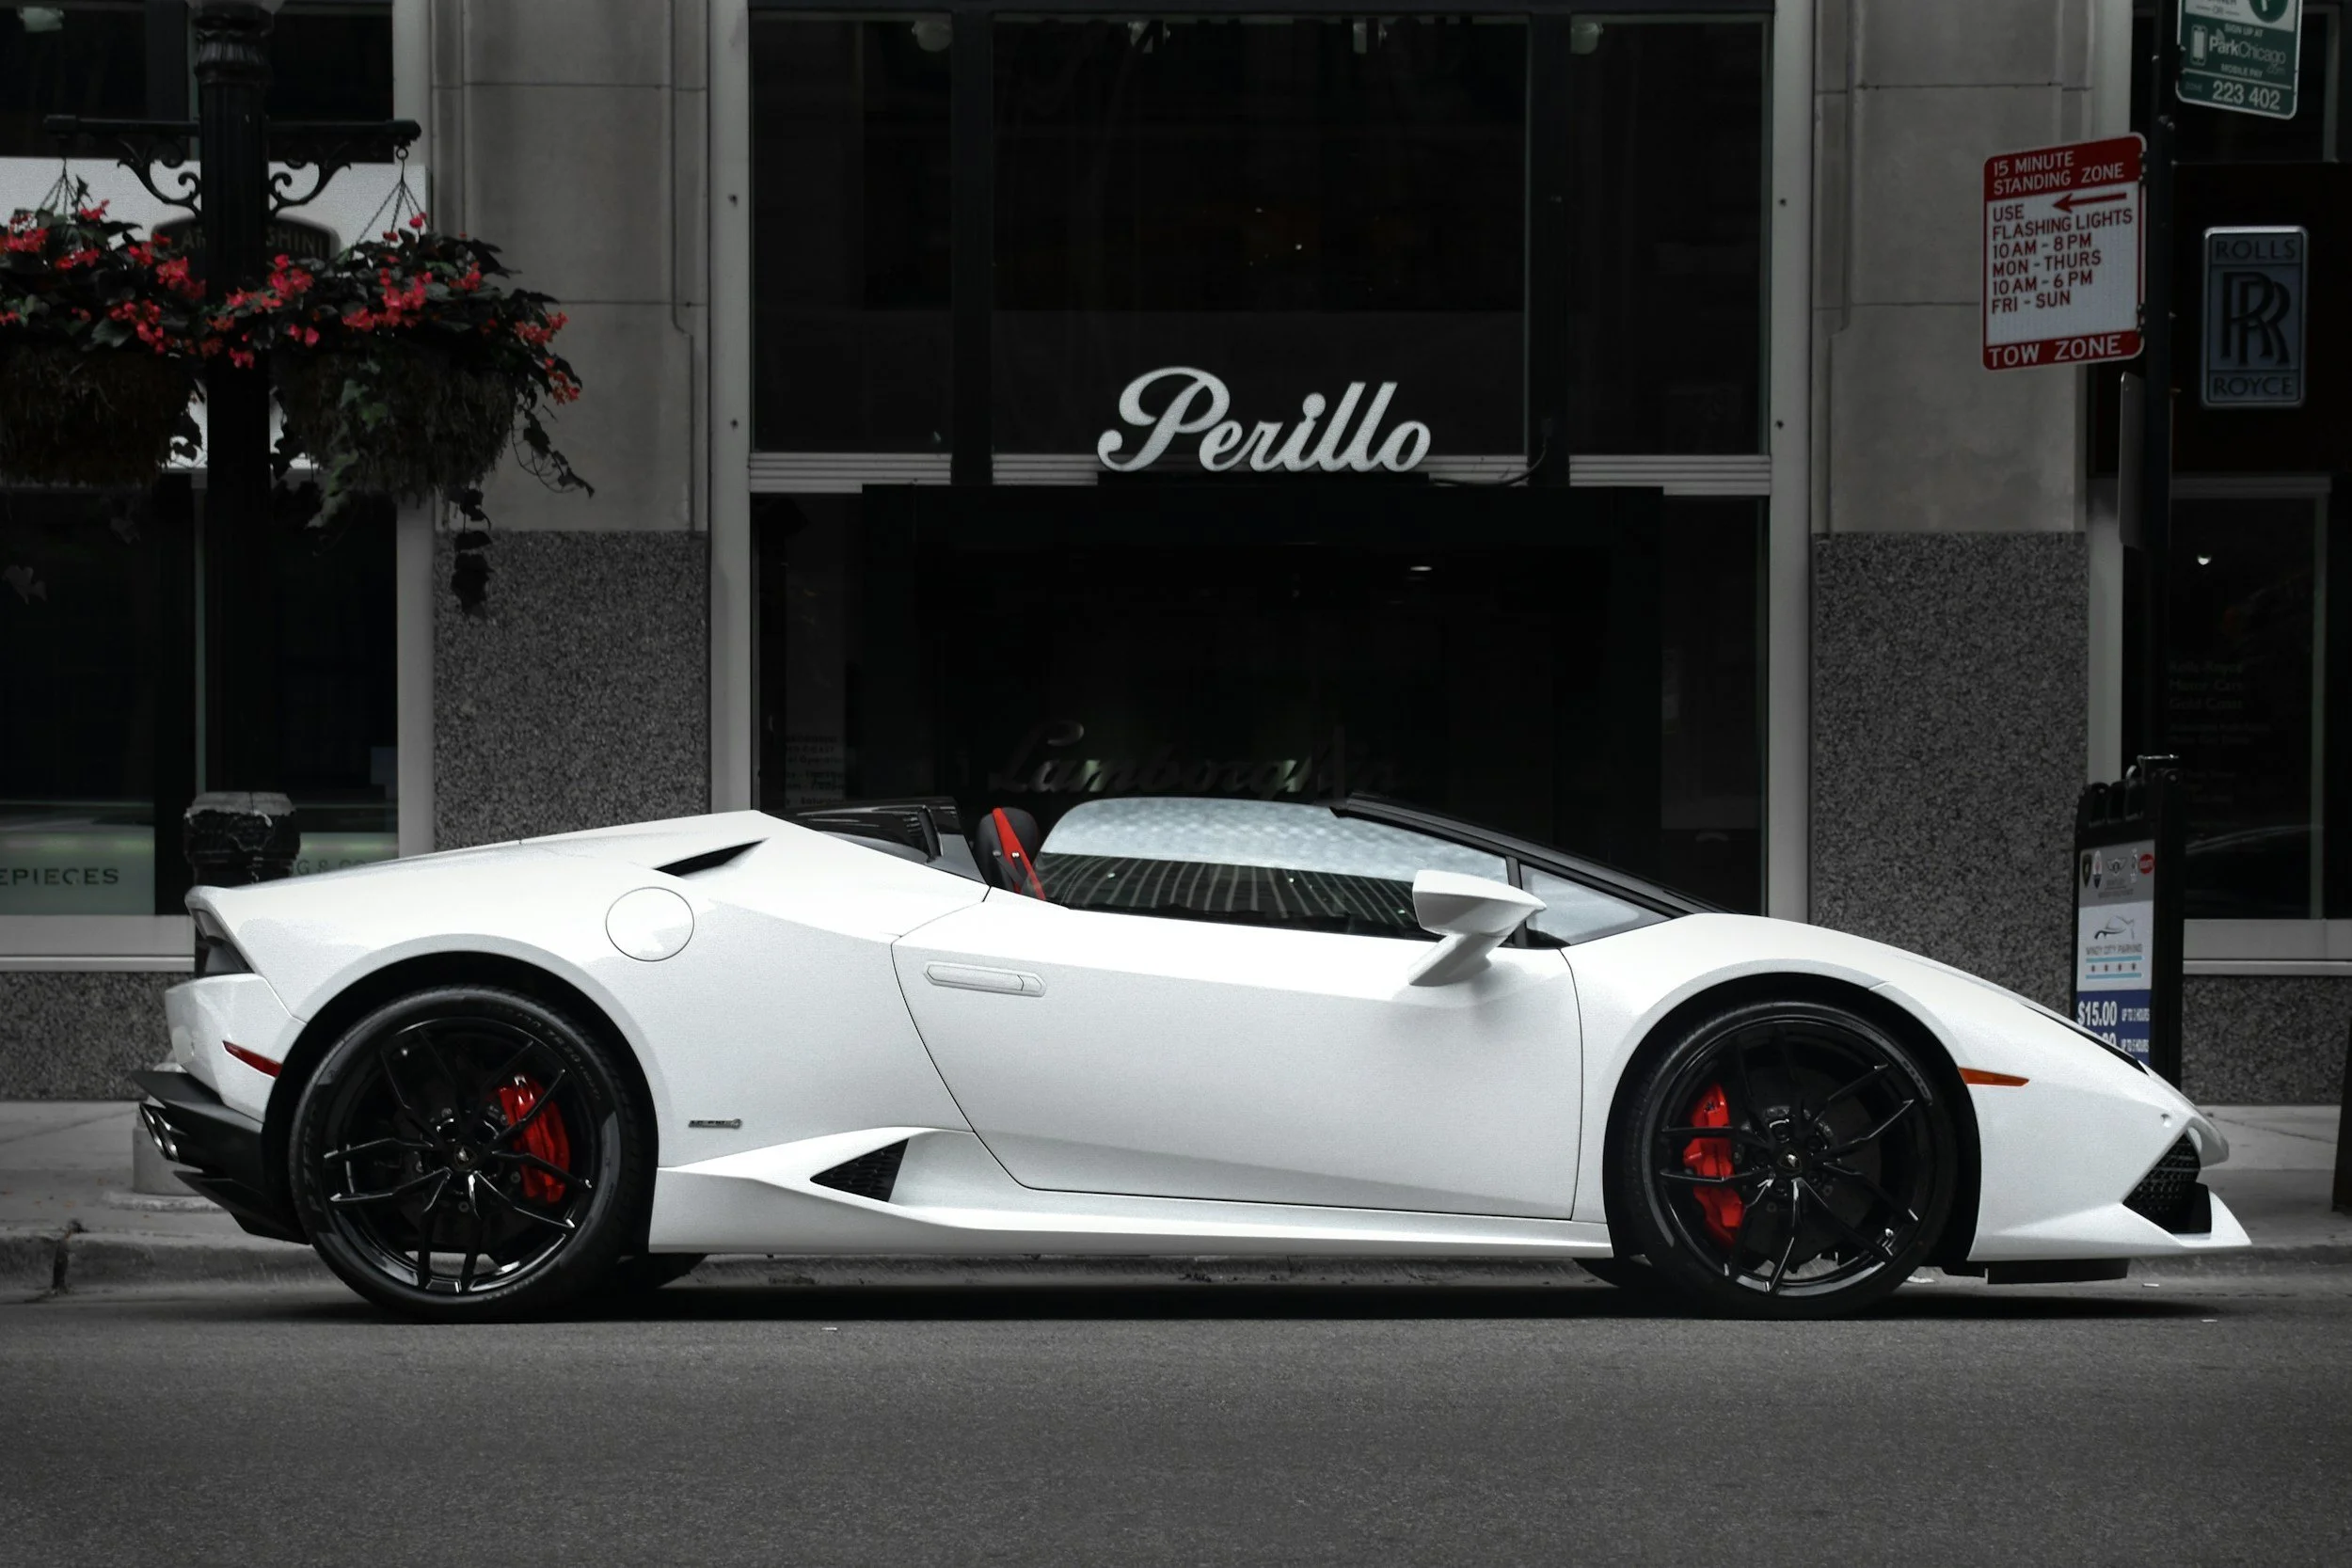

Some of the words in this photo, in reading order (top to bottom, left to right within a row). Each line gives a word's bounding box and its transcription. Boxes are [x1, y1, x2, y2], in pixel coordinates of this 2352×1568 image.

[2209, 34, 2286, 65] ParkChicago
[2213, 80, 2244, 104] 223
[2249, 87, 2280, 110] 402
[1994, 160, 2010, 177] 15
[2015, 150, 2074, 174] MINUTE
[1994, 170, 2072, 196] STANDING
[2081, 162, 2125, 183] ZONE
[1993, 204, 2025, 222] USE
[1993, 216, 2072, 241] FLASHING
[2076, 208, 2133, 230] LIGHTS
[2216, 239, 2296, 260] ROLLS
[1993, 260, 2029, 277] MON
[2044, 250, 2102, 271] THURS
[1993, 296, 2018, 314] FRI
[2036, 291, 2071, 309] SUN
[1988, 342, 2041, 368] TOW
[2055, 334, 2122, 361] ZONE
[2214, 376, 2294, 397] ROYCE
[1097, 366, 1431, 472] Perillo
[988, 719, 1400, 800] Lamborghin
[0, 867, 119, 886] EPIECES
[2077, 1000, 2117, 1027] $15.00
